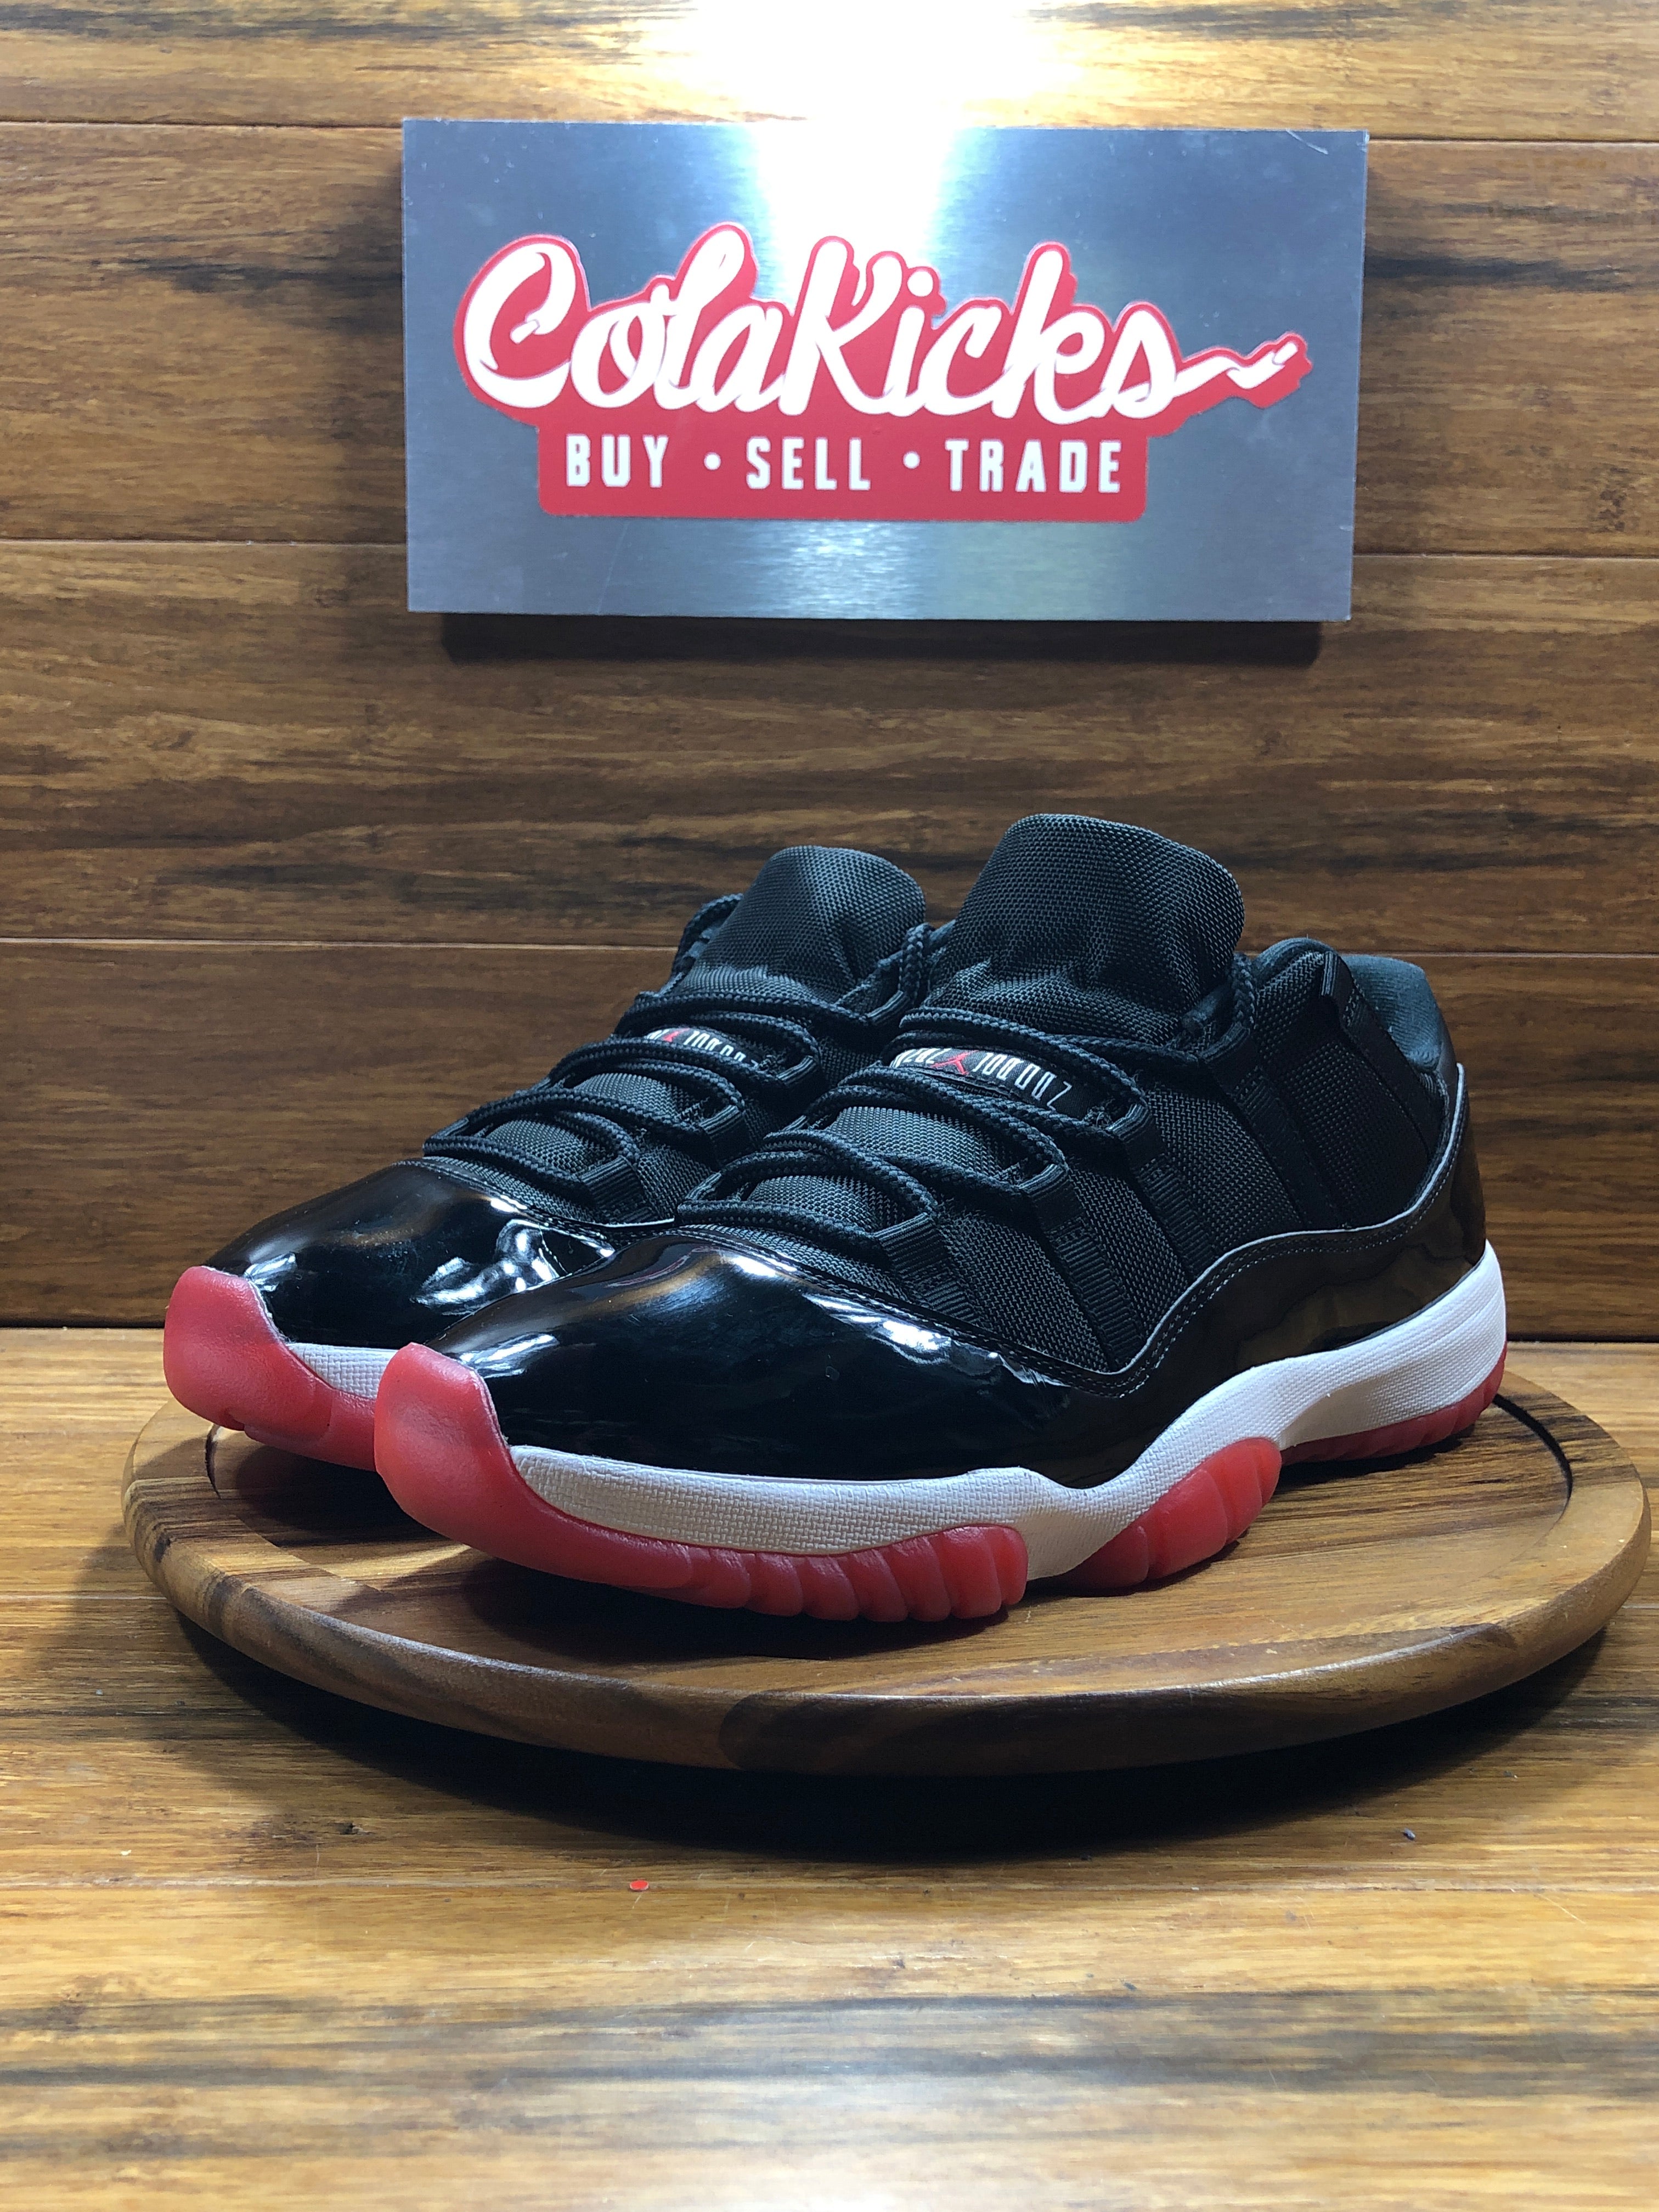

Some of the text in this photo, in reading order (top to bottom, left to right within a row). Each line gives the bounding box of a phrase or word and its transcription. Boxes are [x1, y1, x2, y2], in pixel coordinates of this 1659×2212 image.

[464, 229, 1297, 424] ColaKicks
[566, 434, 1121, 493] BUY SELL TRADE
